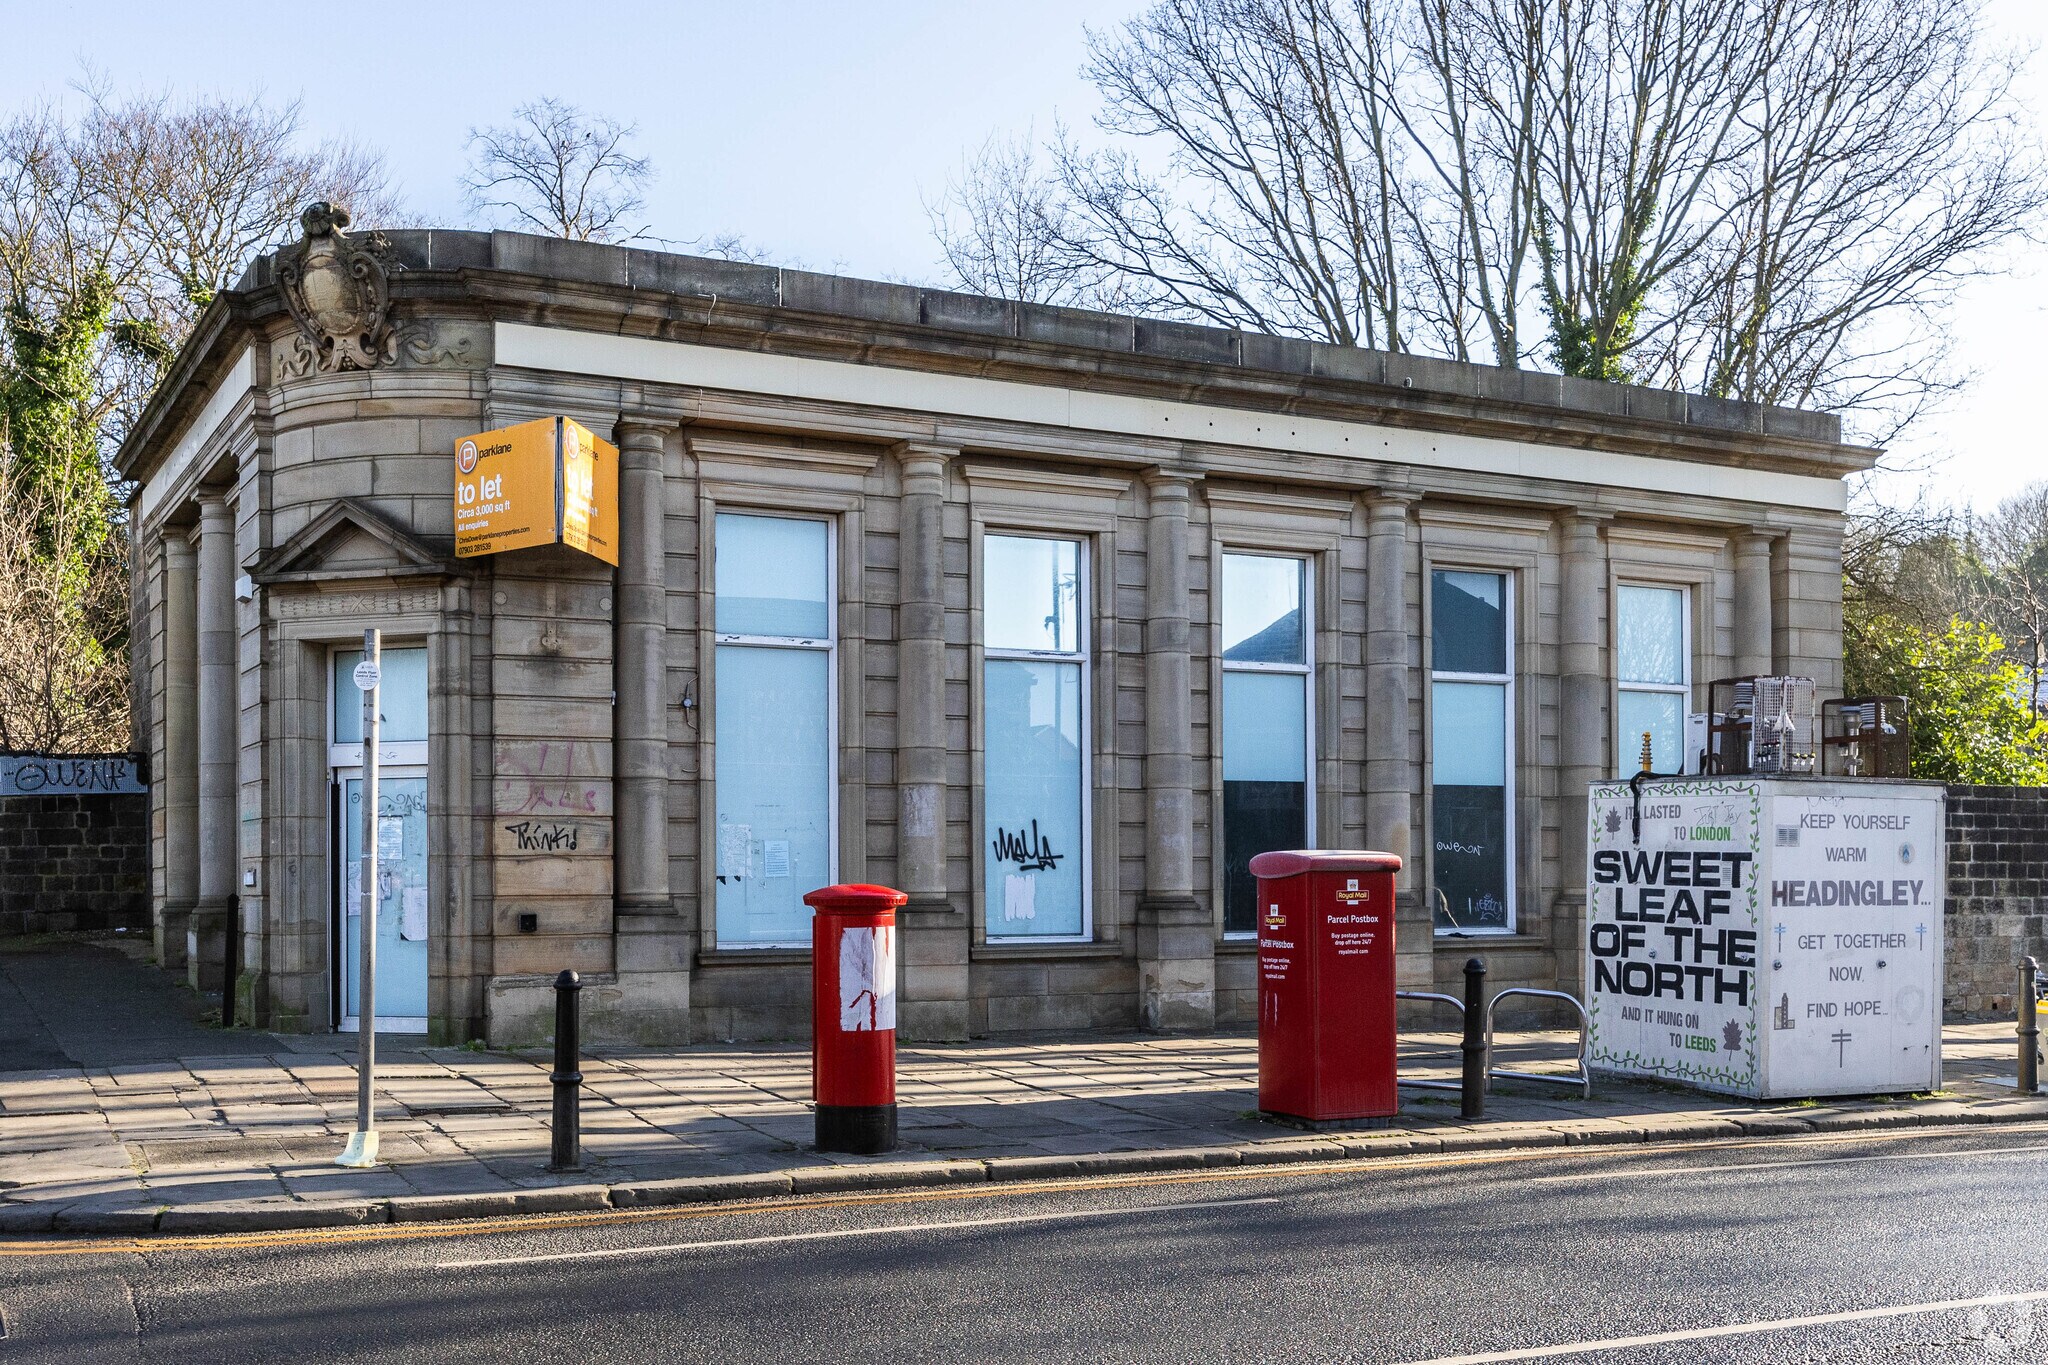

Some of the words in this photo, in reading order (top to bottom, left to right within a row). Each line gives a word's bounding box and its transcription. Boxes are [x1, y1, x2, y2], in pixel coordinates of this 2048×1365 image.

[479, 443, 512, 461] parklane
[458, 481, 476, 505] to
[480, 473, 502, 500] let
[457, 508, 475, 519] Circa
[475, 503, 494, 516] 3,000
[494, 502, 504, 513] sq
[505, 500, 511, 510] ft
[457, 523, 465, 532] All
[465, 520, 489, 531] enquiries
[1800, 813, 1836, 829] KEEP
[1843, 814, 1911, 830] YOURSELF
[1674, 826, 1687, 841] TO
[1825, 847, 1867, 862] WARM
[1593, 850, 1753, 888] SWEET
[1338, 892, 1354, 900] Royal
[1615, 887, 1731, 925] LEAF
[1327, 915, 1349, 924] Parcel
[1351, 915, 1379, 923] Postbox
[1272, 940, 1295, 949] Postbox
[1590, 923, 1646, 958] OF
[1664, 926, 1757, 968] THE
[1798, 934, 1826, 950] GET
[1834, 933, 1906, 949] TOGETHER
[1594, 959, 1748, 1006] NORTH
[1621, 1006, 1641, 1021] AND
[1645, 1009, 1654, 1023] IT
[1657, 1010, 1683, 1027] HUNG
[1685, 1013, 1699, 1029] ON
[1807, 1002, 1838, 1018] FIND
[1669, 1032, 1682, 1048] TO
